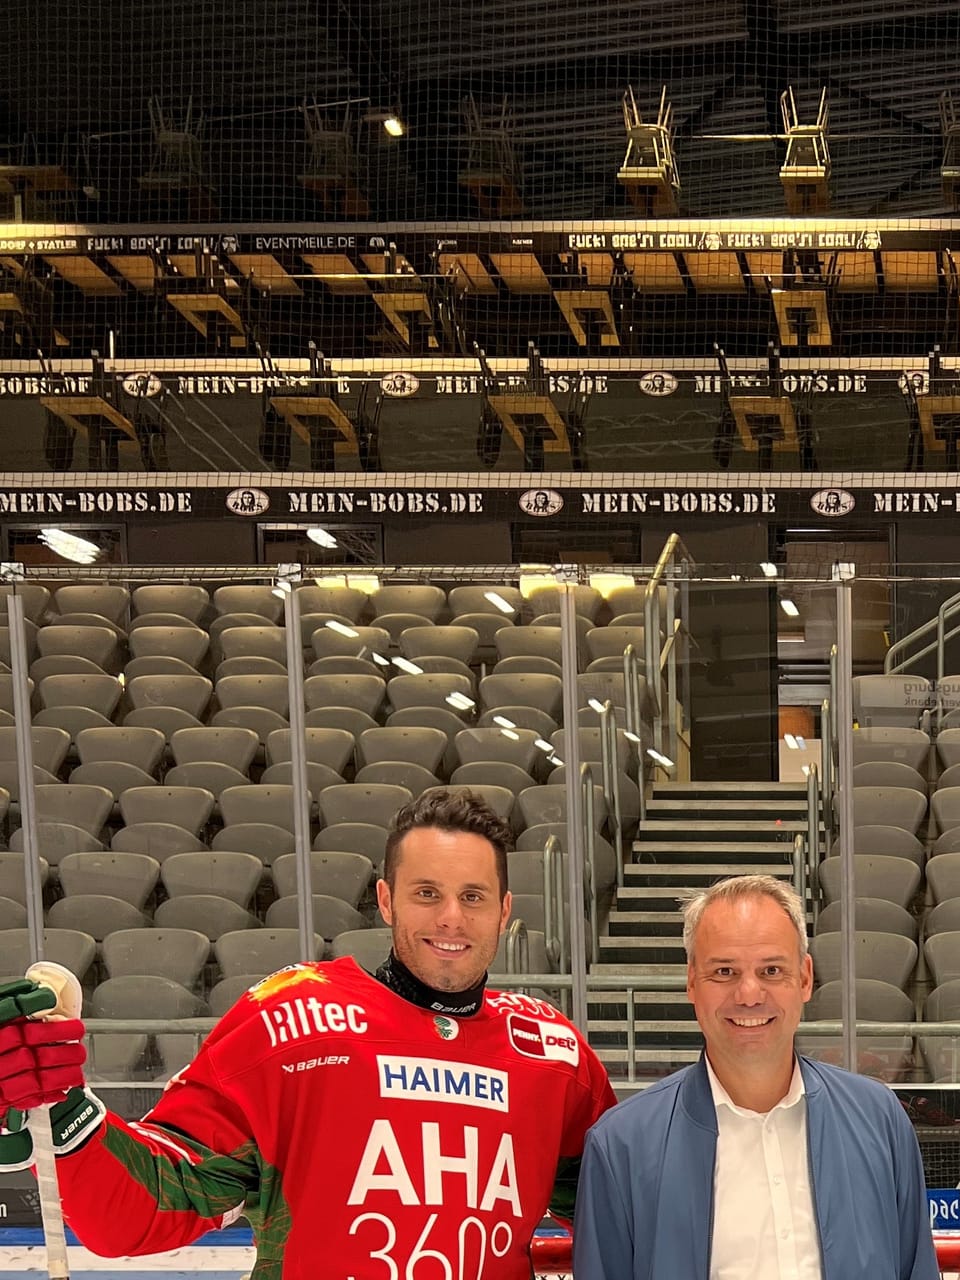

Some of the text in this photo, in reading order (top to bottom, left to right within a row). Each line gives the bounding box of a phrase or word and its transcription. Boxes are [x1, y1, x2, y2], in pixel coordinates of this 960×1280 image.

[256, 236, 356, 249] EVENTMEILE.DE
[0, 492, 192, 513] MEIN-BOBS.DE
[288, 492, 483, 513] MEIN-BOBS.DE
[581, 492, 776, 513] MEIN-BOBS.DE
[296, 1055, 351, 1071] BAUER
[384, 1063, 504, 1103] HAIMER
[61, 1105, 94, 1140] BAUER
[346, 1118, 524, 1218] AHA
